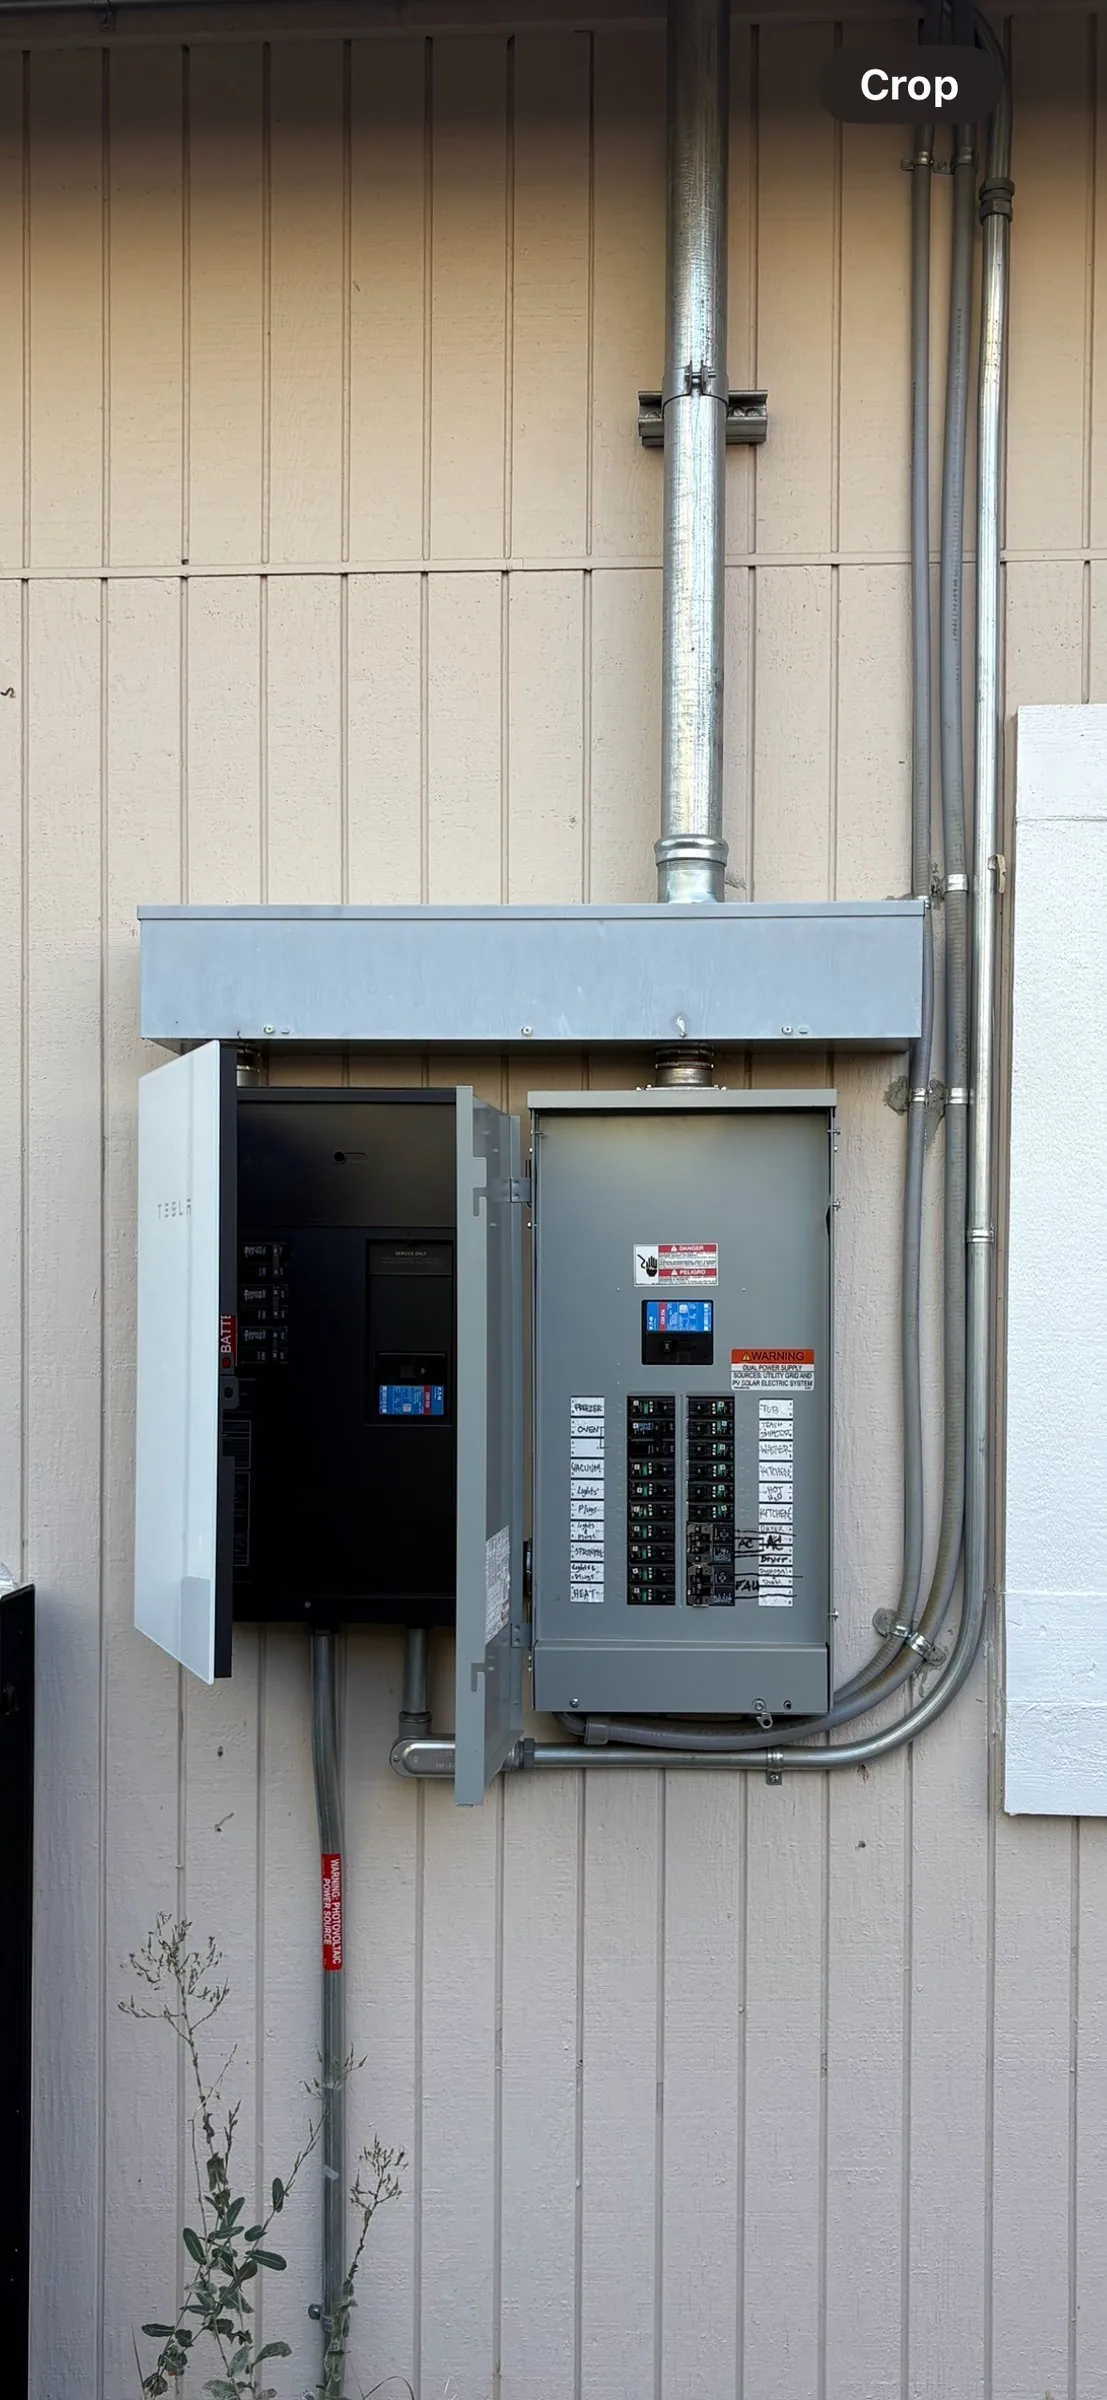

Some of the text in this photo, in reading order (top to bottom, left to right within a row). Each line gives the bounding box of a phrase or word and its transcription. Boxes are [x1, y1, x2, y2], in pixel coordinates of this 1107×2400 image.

[158, 1198, 192, 1220] TESLA
[752, 1351, 805, 1361] WARNING
[760, 1404, 779, 1414] TUB
[577, 1425, 600, 1433] OVEN
[573, 1588, 595, 1600] HEAT
[323, 1878, 332, 1945] POWER SOURCE
[332, 1902, 341, 1965] PHOTOVOLTAIC
